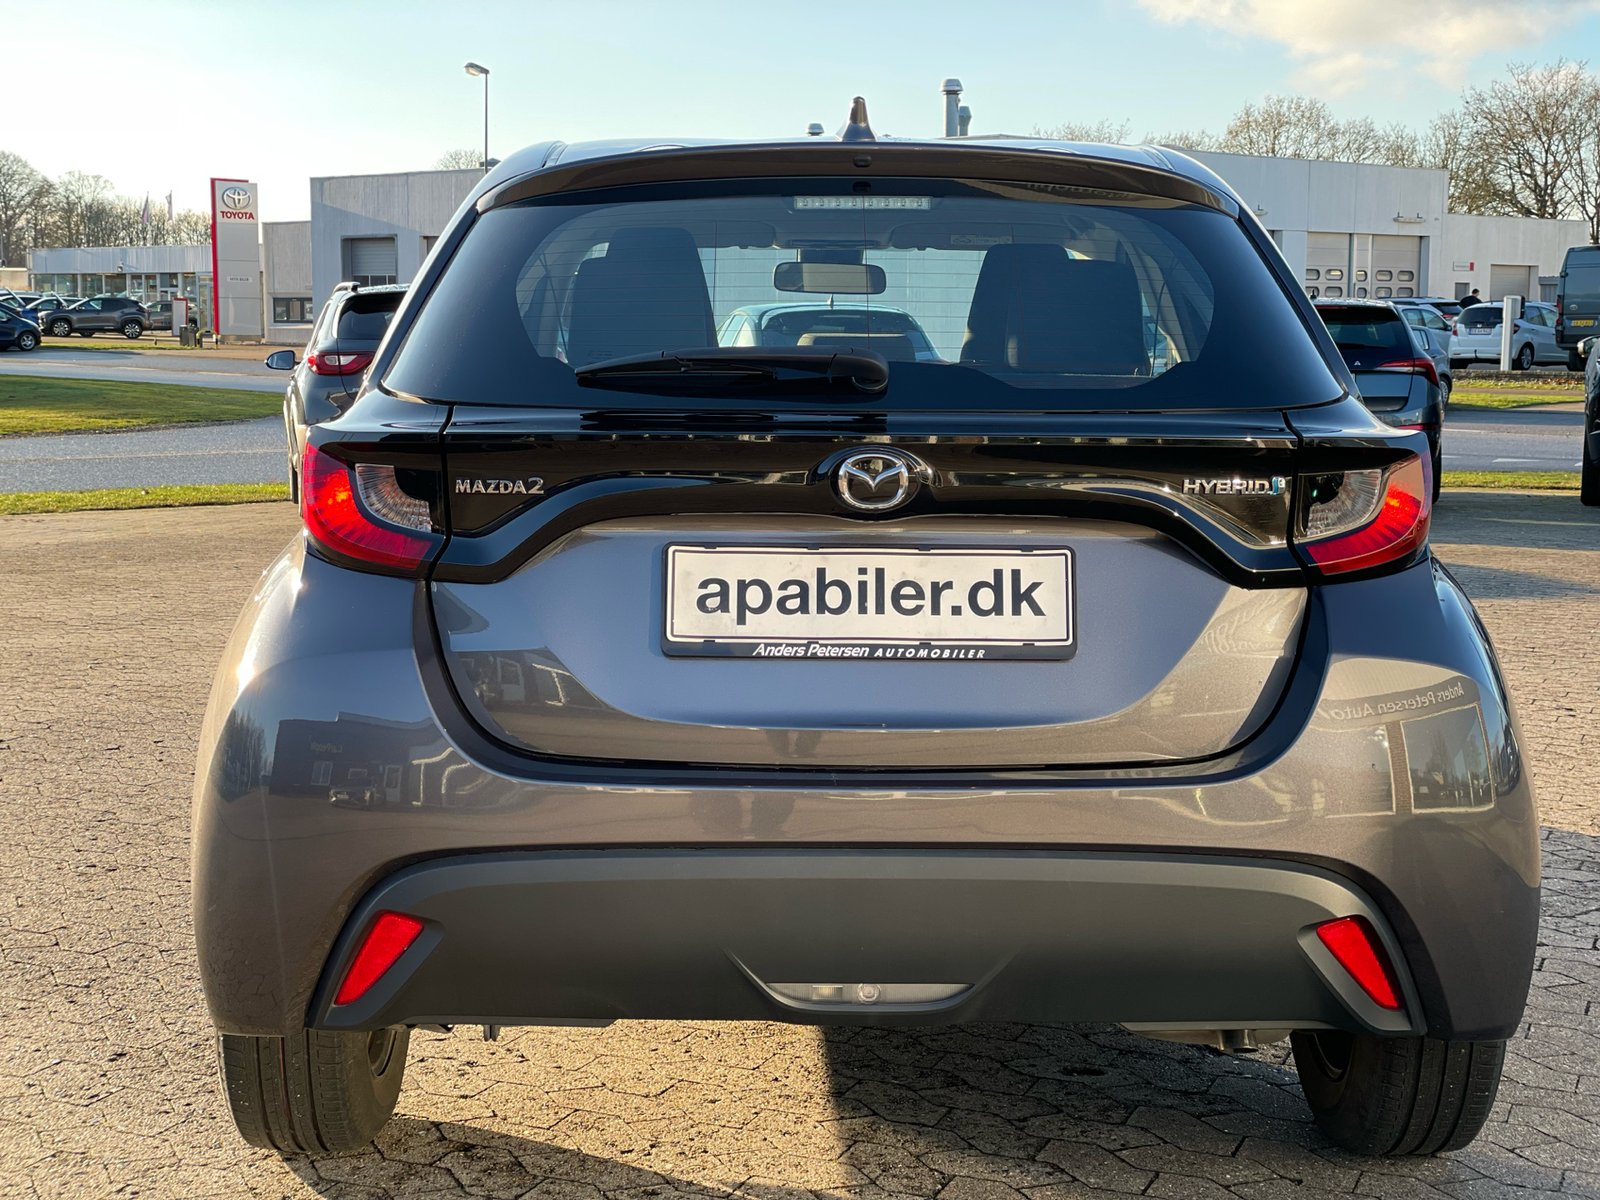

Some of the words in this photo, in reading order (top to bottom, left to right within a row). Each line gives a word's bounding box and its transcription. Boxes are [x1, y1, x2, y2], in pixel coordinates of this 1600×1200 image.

[220, 210, 255, 220] TOYOTA
[455, 477, 545, 495] MAZDA2
[1183, 478, 1270, 495] HYBRID
[695, 567, 1047, 626] apabiler.dk
[752, 643, 806, 657] Anders
[806, 643, 870, 658] Petersen
[873, 647, 986, 659] AUTOMOBILER
